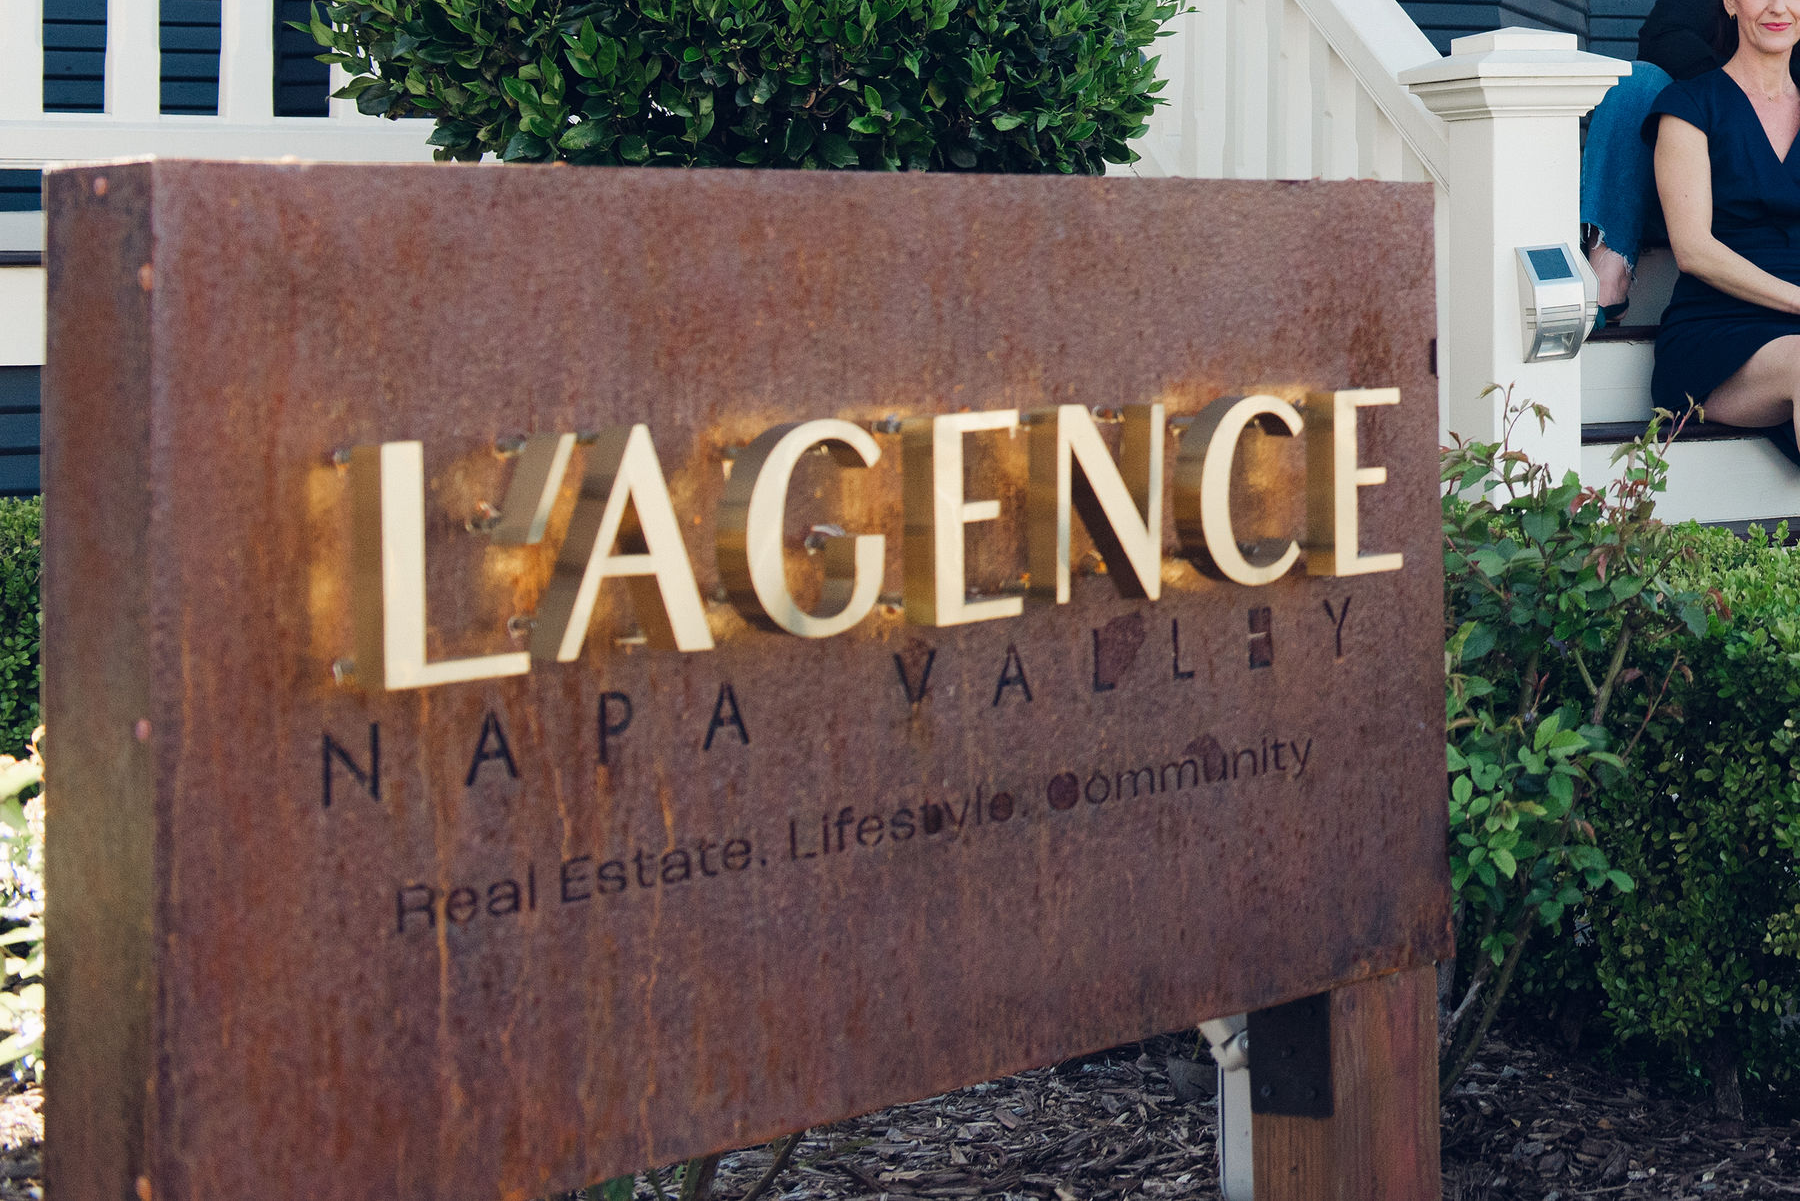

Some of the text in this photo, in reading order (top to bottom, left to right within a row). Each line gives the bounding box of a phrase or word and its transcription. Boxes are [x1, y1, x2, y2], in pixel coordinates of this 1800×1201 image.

[378, 387, 1404, 691] L'AGENCE
[321, 683, 750, 806] NAPA
[396, 863, 537, 933] Real
[560, 835, 767, 904] Estate.
